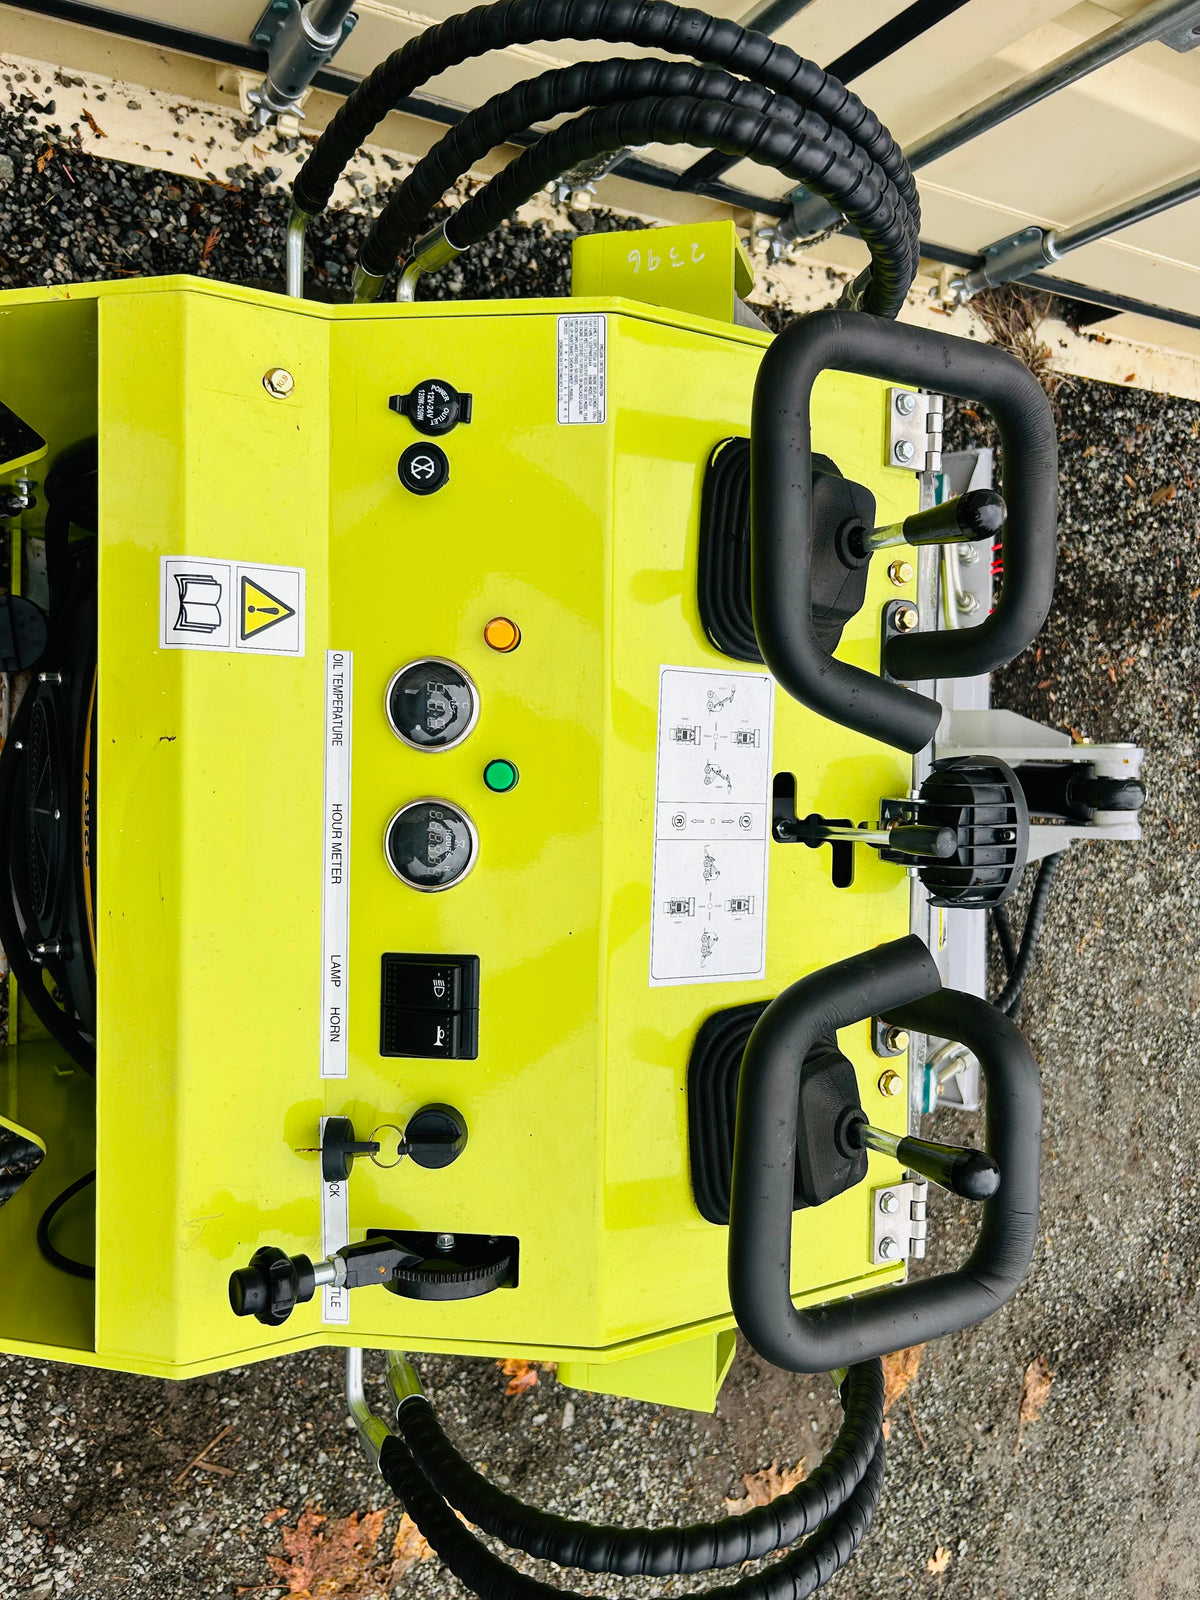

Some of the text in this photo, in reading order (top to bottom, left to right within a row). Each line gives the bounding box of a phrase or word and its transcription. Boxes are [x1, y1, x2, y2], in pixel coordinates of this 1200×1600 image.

[426, 391, 434, 418] 12V-24V
[430, 385, 450, 426] POWER OUTLET
[331, 653, 344, 746] OIL TEMPERATURE
[330, 803, 343, 884] HOUR METER
[330, 954, 342, 987] LAMP
[330, 1007, 341, 1042] HORN
